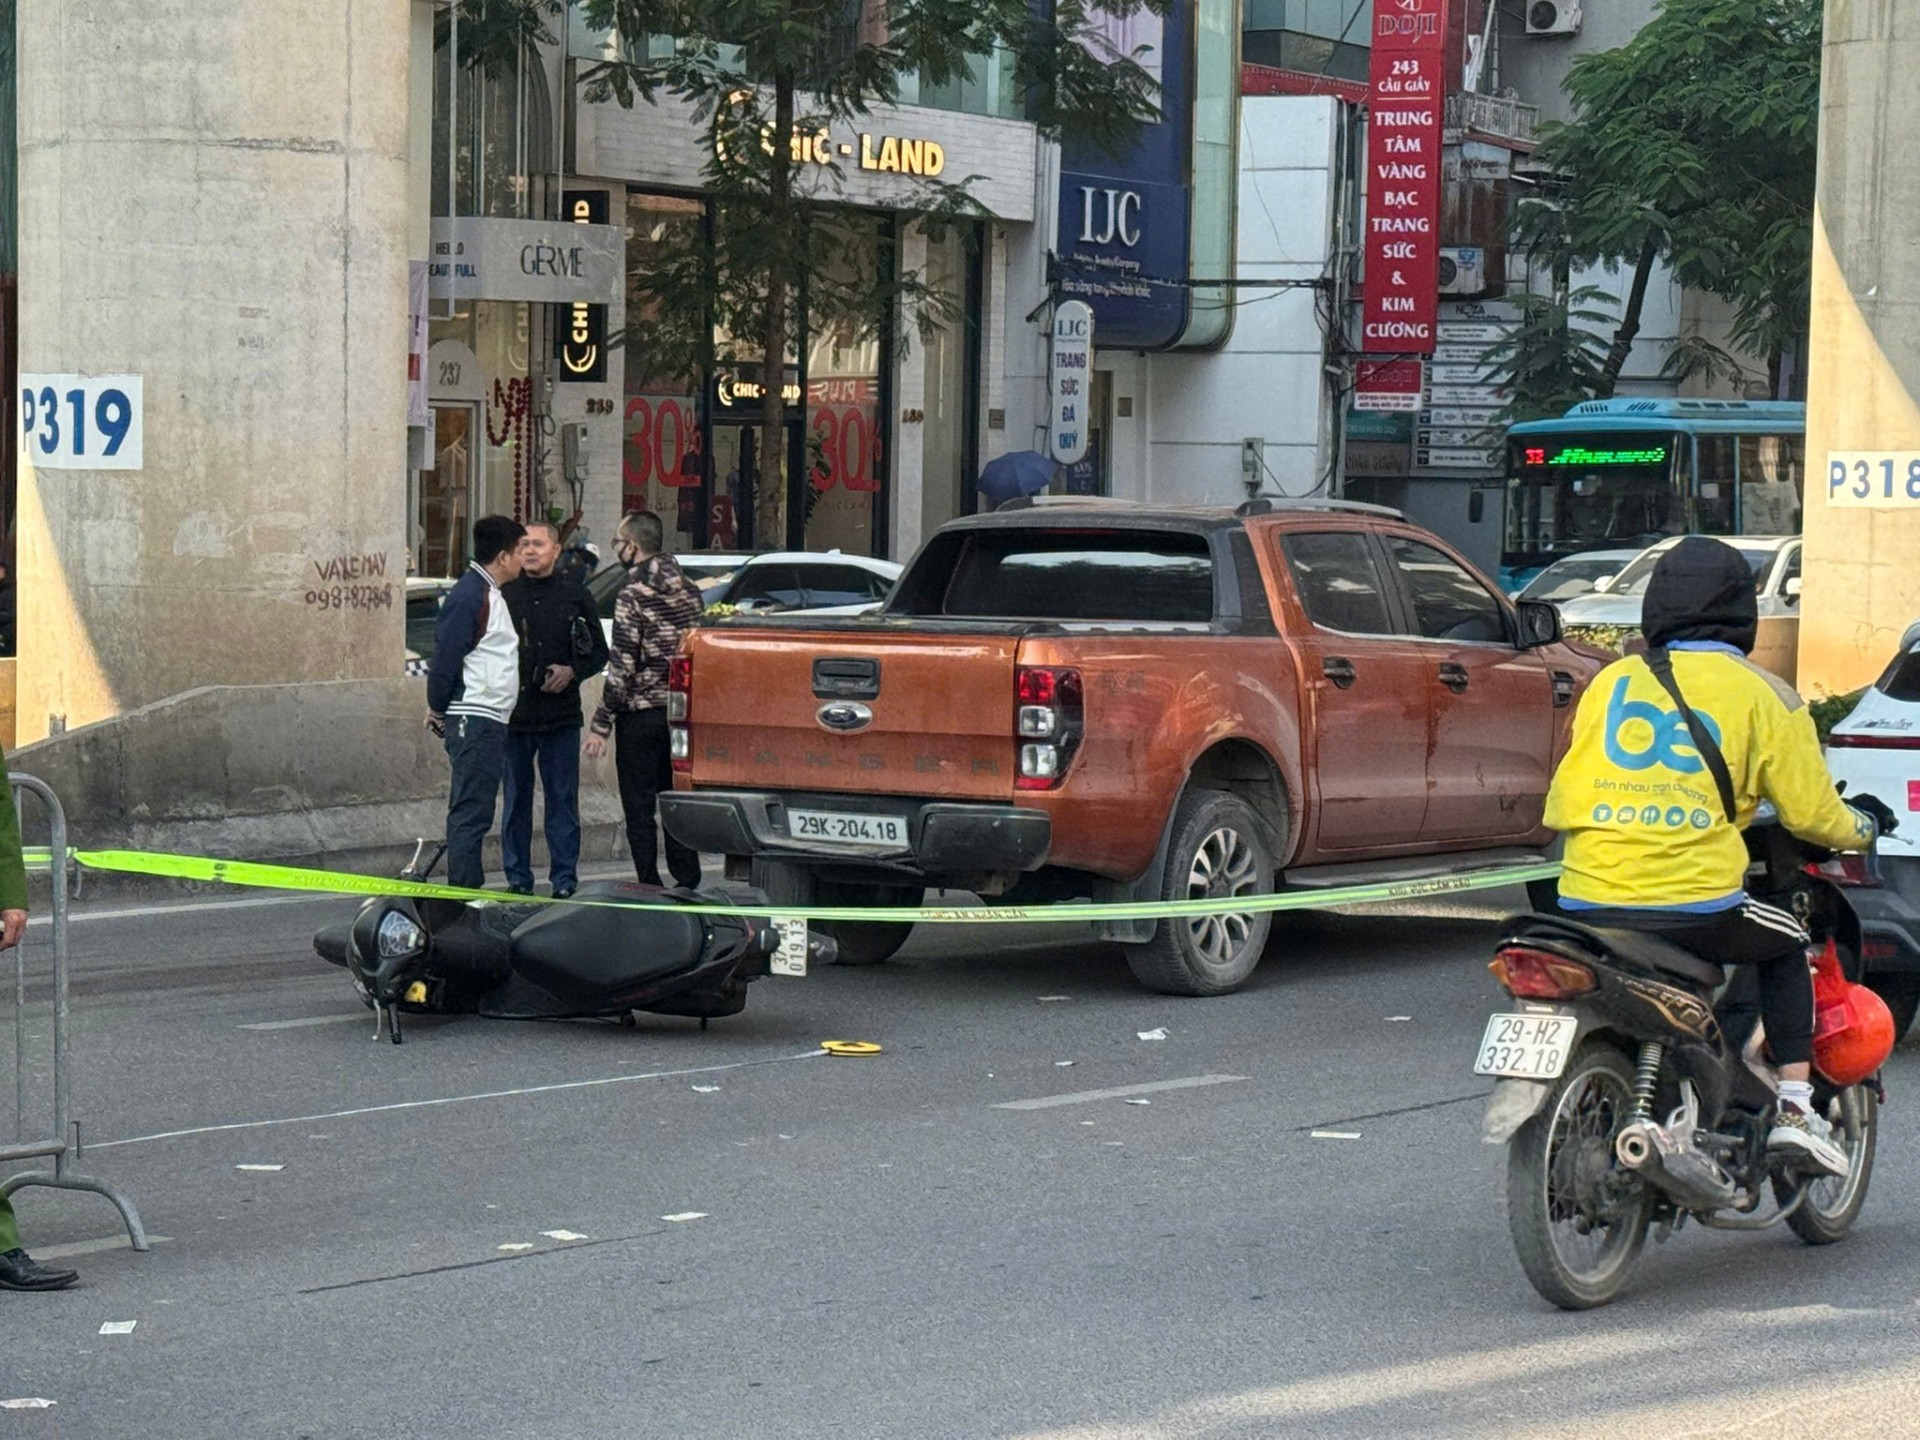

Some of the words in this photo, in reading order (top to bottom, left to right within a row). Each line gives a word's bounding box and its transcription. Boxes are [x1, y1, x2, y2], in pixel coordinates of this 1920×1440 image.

[1377, 12, 1437, 43] DOJI
[1391, 60, 1419, 75] 243
[1378, 76, 1401, 92] CẦU
[1404, 75, 1430, 92] GIẤY
[1375, 111, 1433, 126] TRUNG
[1384, 134, 1421, 153] TÂM
[861, 132, 945, 177] LAND
[1377, 162, 1426, 179] VÀNG
[1384, 191, 1419, 209] BẠC
[1079, 186, 1141, 247] IJC
[1371, 217, 1430, 232] TRANG
[435, 242, 464, 256] HELO
[1382, 241, 1417, 258] SỨC
[1391, 270, 1407, 285] &
[1382, 297, 1415, 312] KIM
[1366, 321, 1429, 338] CƯƠNG
[1056, 353, 1086, 369] TRANG
[439, 361, 461, 386] 237
[733, 382, 759, 398] CHIC
[22, 386, 132, 456] P319
[1062, 403, 1075, 422] ĐÁ
[1829, 459, 1920, 499] P318
[1604, 675, 1722, 775] be
[705, 746, 998, 774] RANGER
[1619, 781, 1650, 793] nhau
[798, 815, 897, 841] 29K-204.18
[1496, 1019, 1562, 1045] 29-H2
[1482, 1046, 1560, 1074] 332.18
